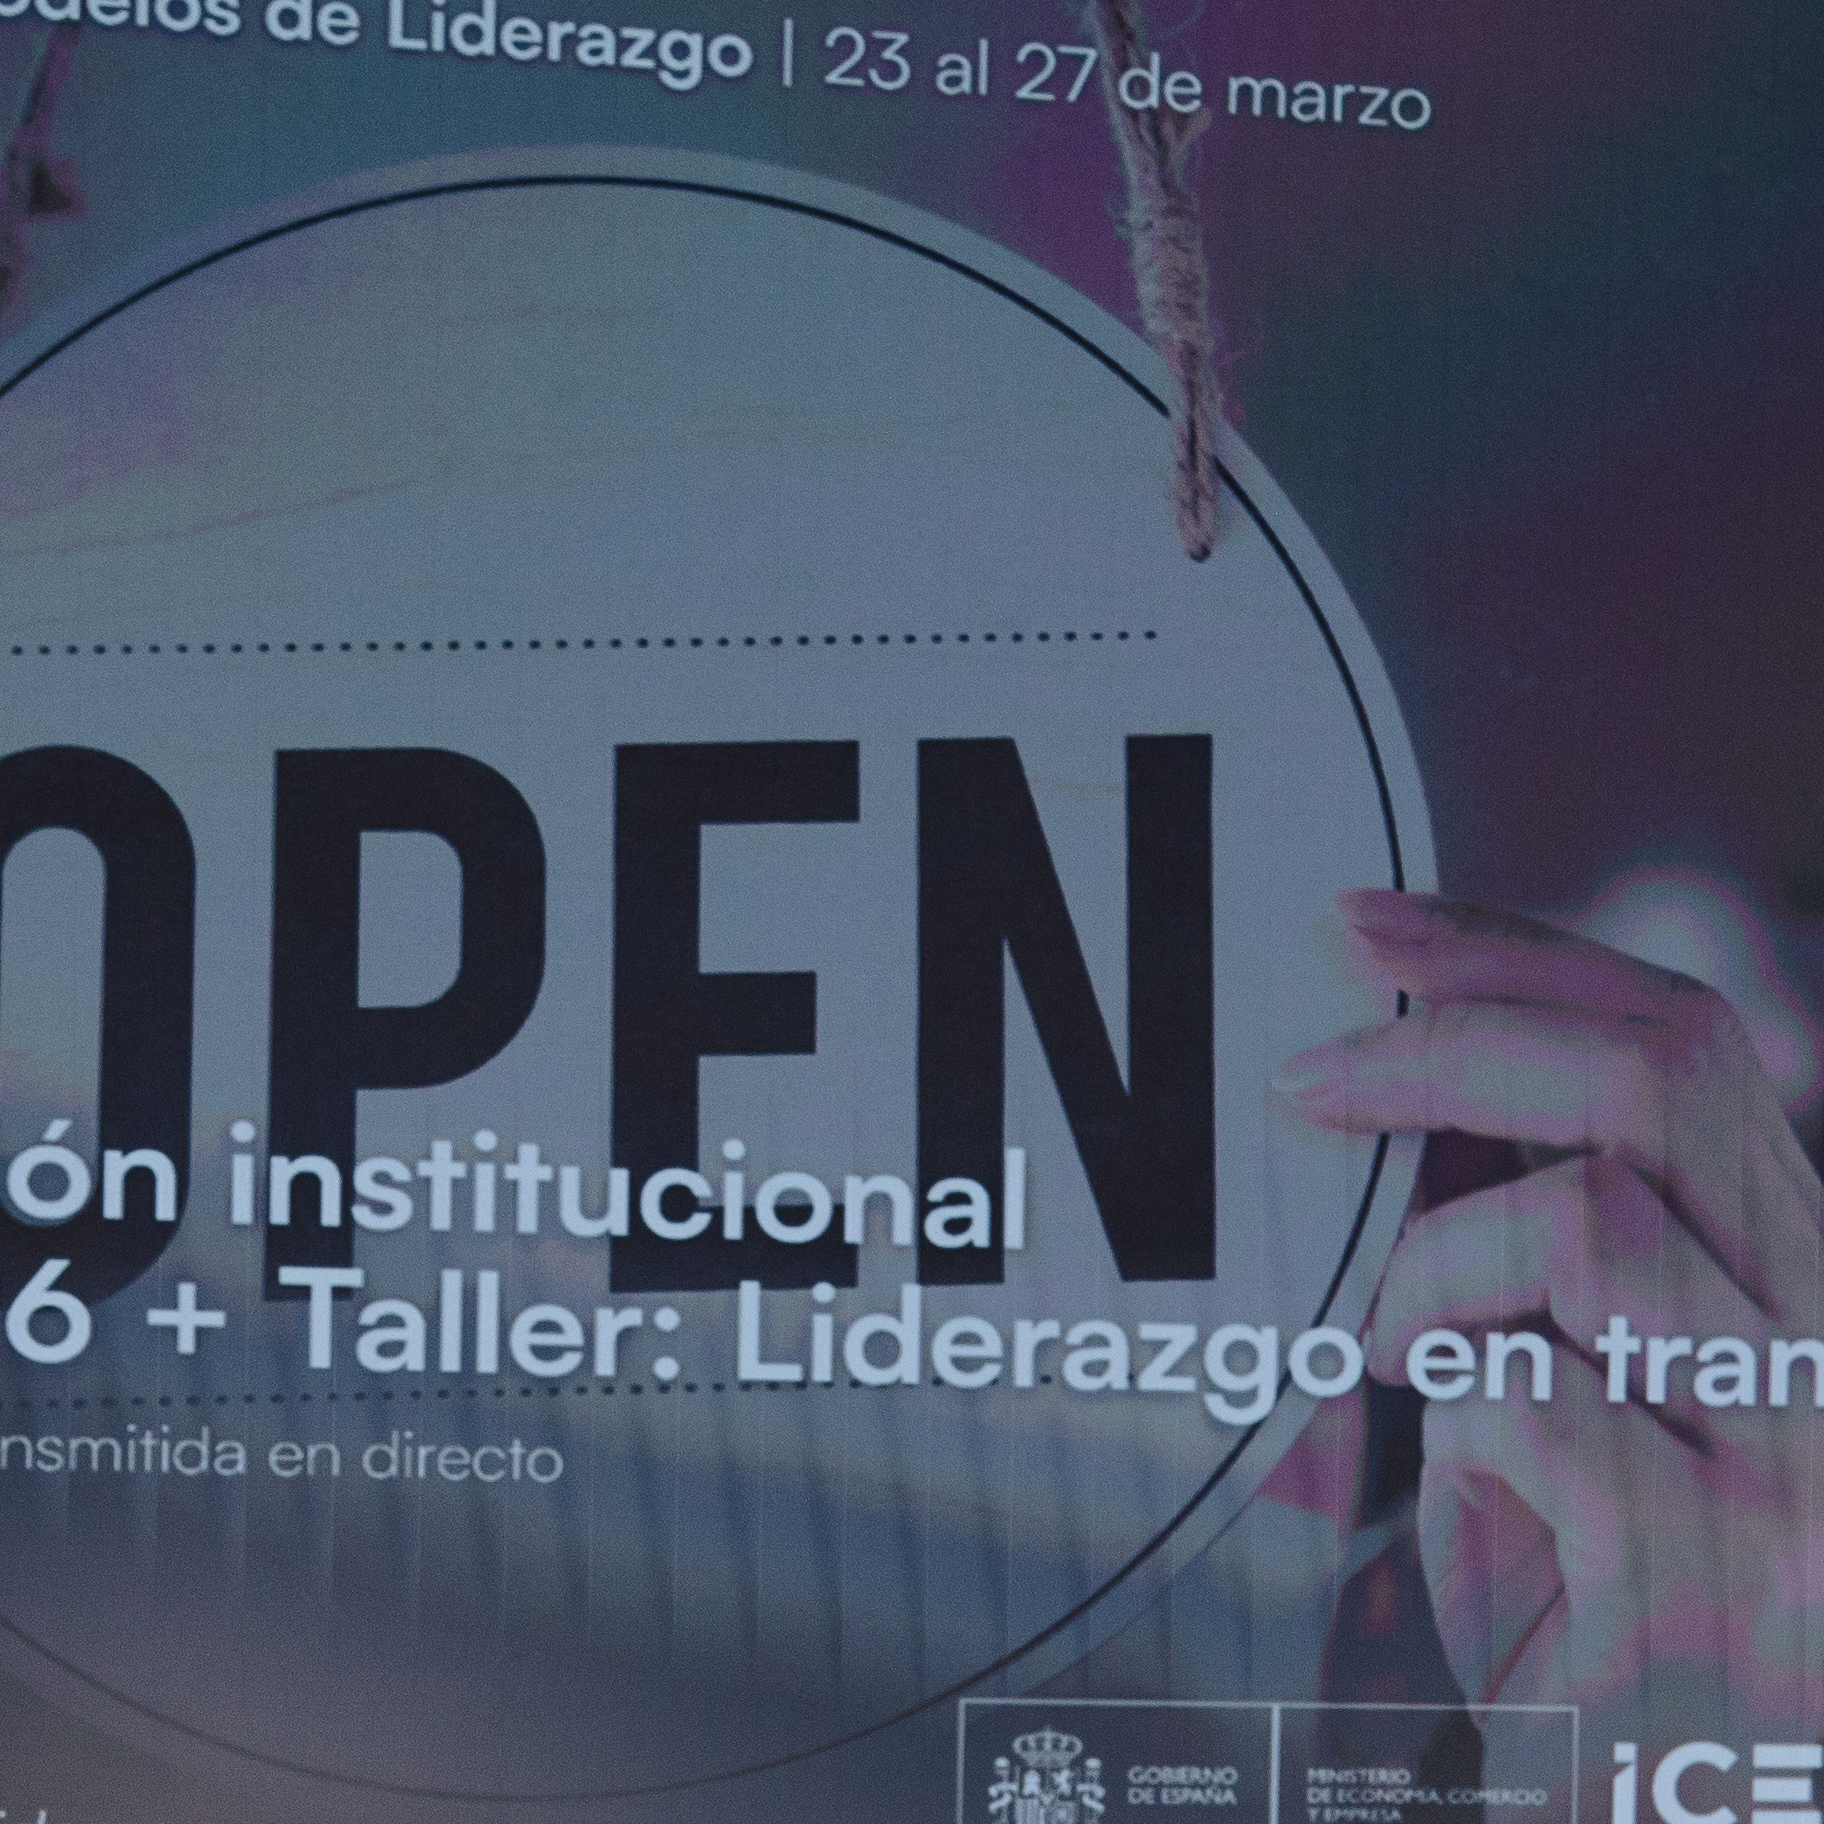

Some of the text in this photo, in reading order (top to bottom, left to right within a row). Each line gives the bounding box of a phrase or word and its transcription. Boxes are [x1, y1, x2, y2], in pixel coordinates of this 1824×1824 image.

[264, 0, 362, 46] de
[388, 0, 754, 91] Liderazgo
[824, 27, 912, 91] 23
[935, 38, 989, 96] al
[1015, 42, 1098, 102] 27
[1118, 52, 1203, 113] de
[1227, 75, 1432, 131] marzo
[230, 1120, 1026, 1251] institucional
[147, 1282, 226, 1355] +
[278, 1265, 681, 1382] Taller:
[737, 1280, 1365, 1425] Liderazgo
[1405, 1328, 1552, 1400] en
[268, 1439, 342, 1477] en
[362, 1430, 564, 1483] directo
[1127, 1764, 1239, 1786] GOBIERNO
[1127, 1786, 1157, 1806] DE
[1306, 1786, 1332, 1804] DE
